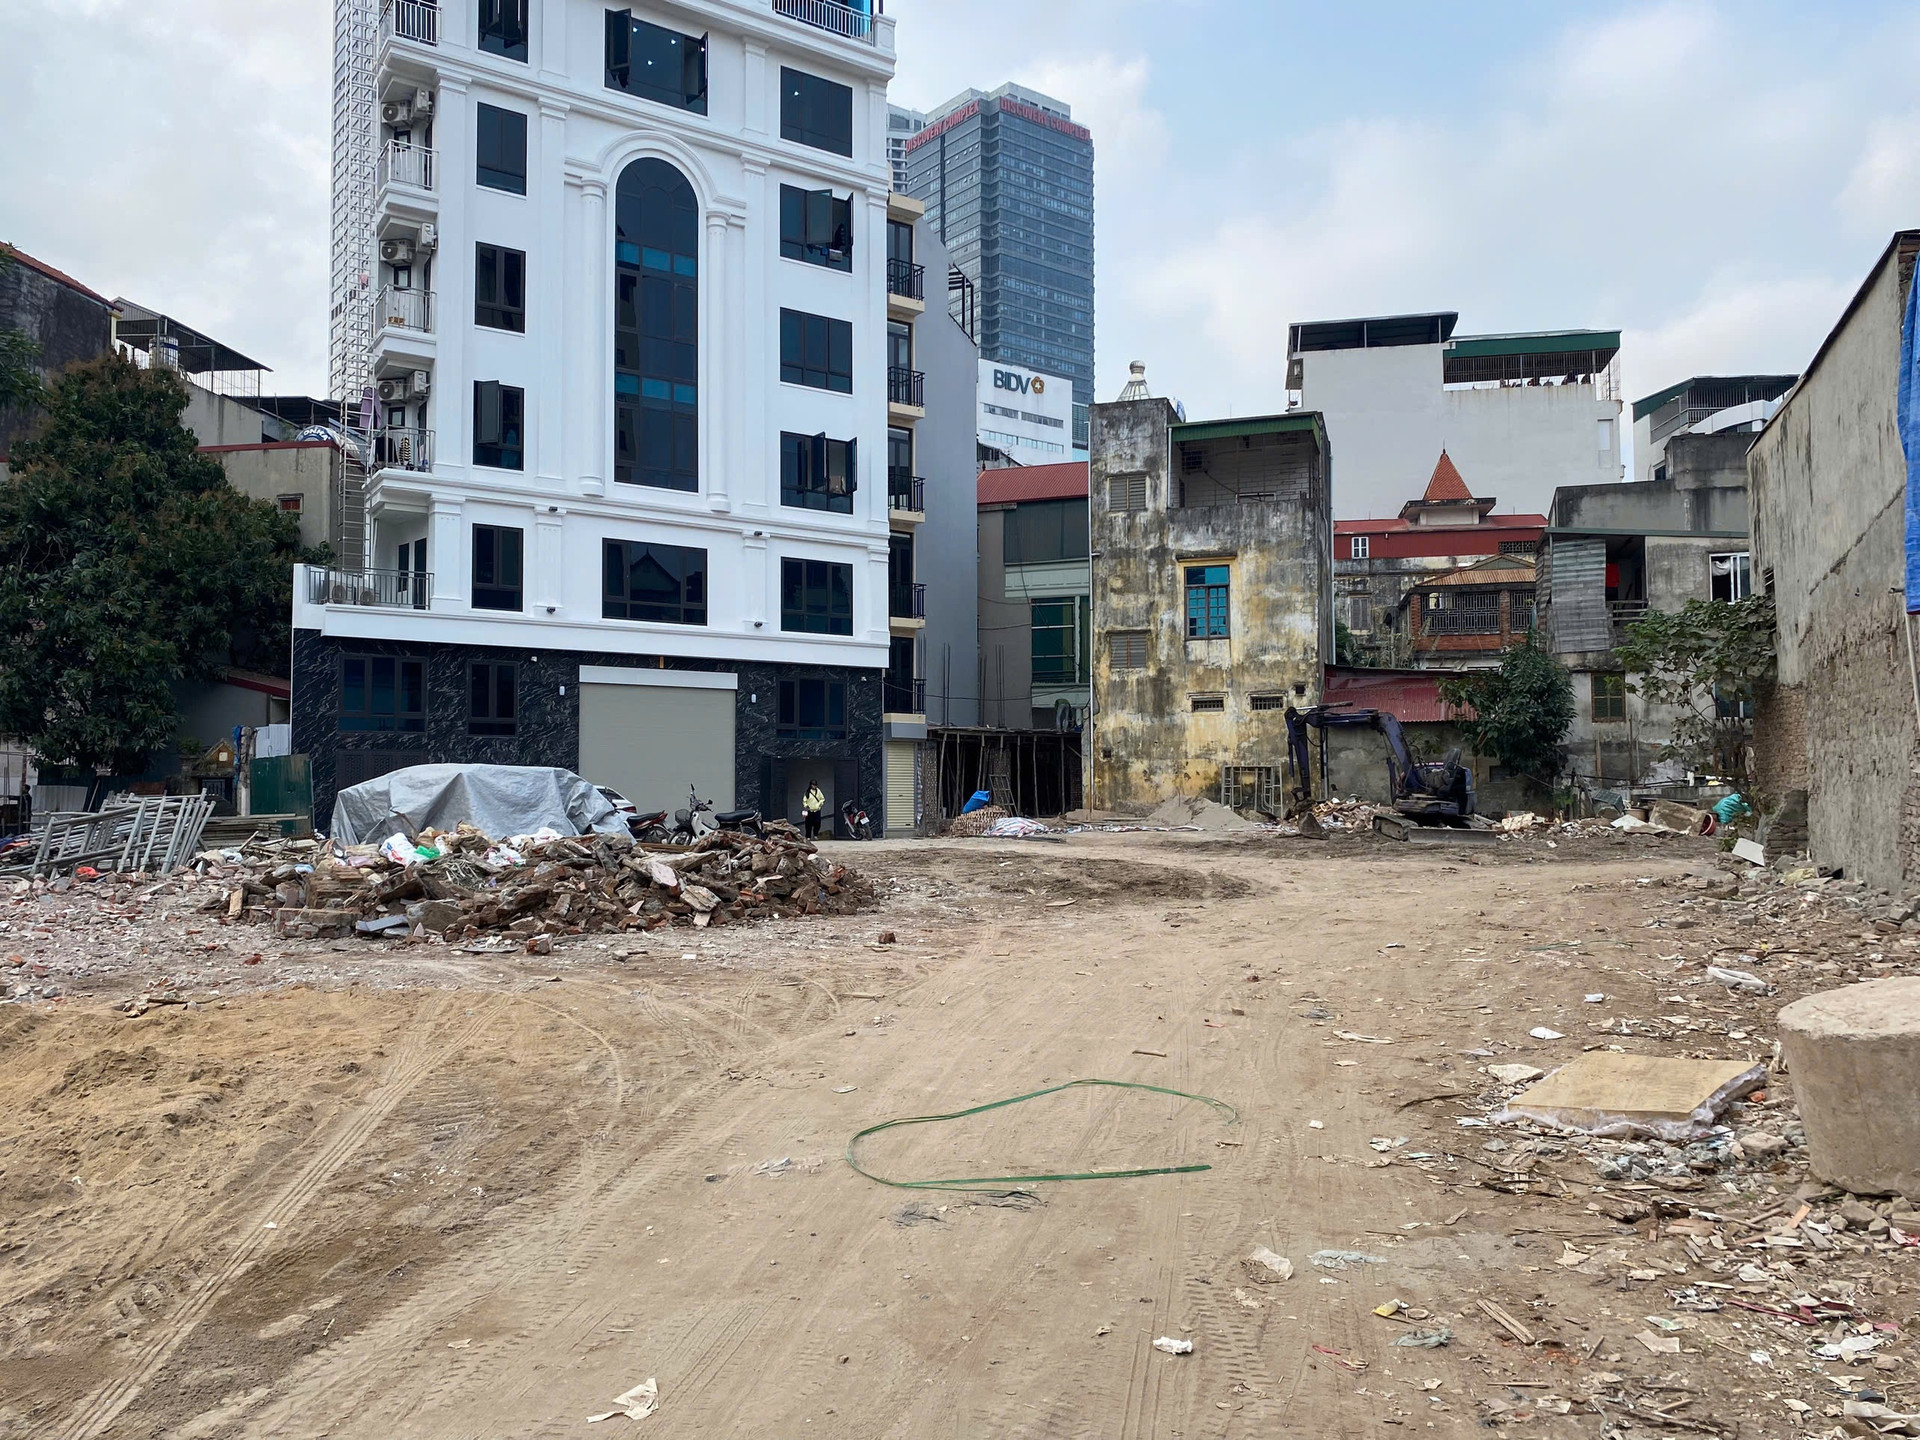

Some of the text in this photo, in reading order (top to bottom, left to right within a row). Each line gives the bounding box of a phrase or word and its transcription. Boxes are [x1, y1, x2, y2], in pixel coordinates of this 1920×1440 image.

[906, 101, 980, 153] DISCOVERY COMPLEX
[1000, 97, 1091, 141] DISCOVERY COMPLEX
[994, 369, 1031, 394] BIDV
